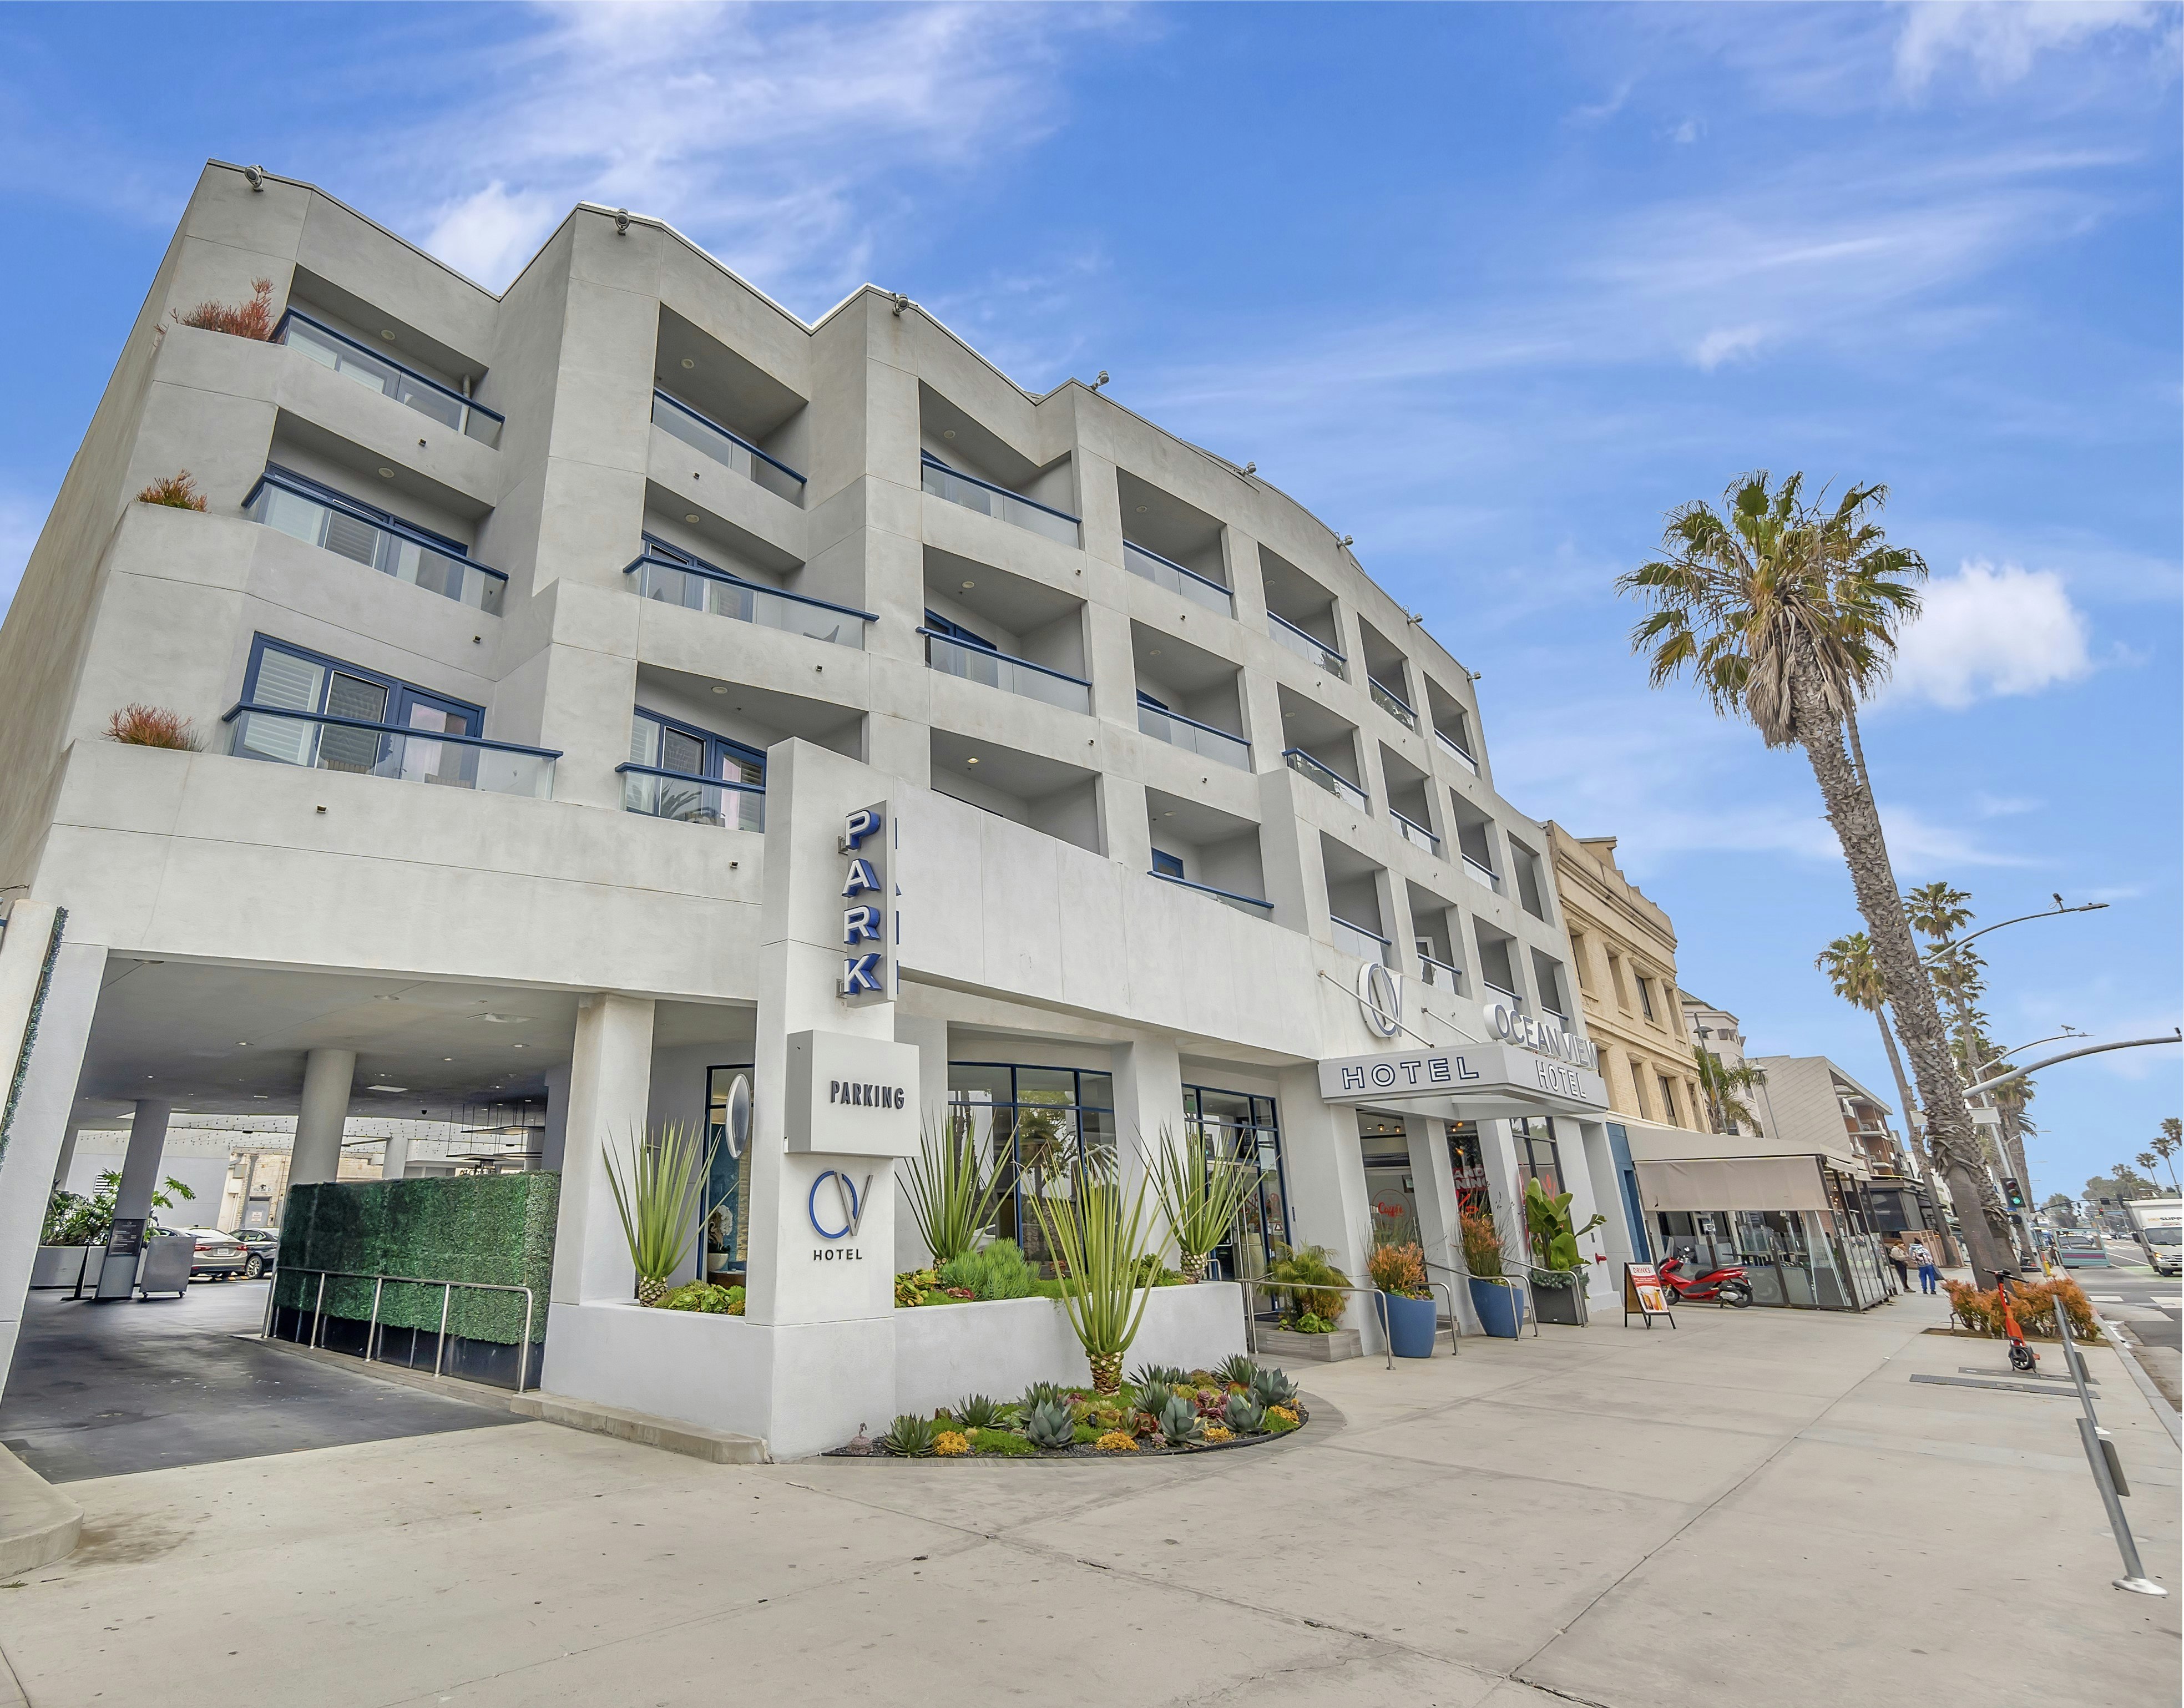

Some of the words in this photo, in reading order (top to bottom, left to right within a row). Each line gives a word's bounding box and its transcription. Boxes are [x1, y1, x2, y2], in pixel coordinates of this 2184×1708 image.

[842, 809, 881, 996] PARK
[1484, 1004, 1561, 1059] OCEAN
[1560, 1030, 1599, 1071] VIEW
[1342, 1056, 1480, 1090] HOTEL
[1535, 1060, 1586, 1099] HOTEL
[831, 1080, 905, 1109] PARKING
[813, 1249, 863, 1261] HOTEL
